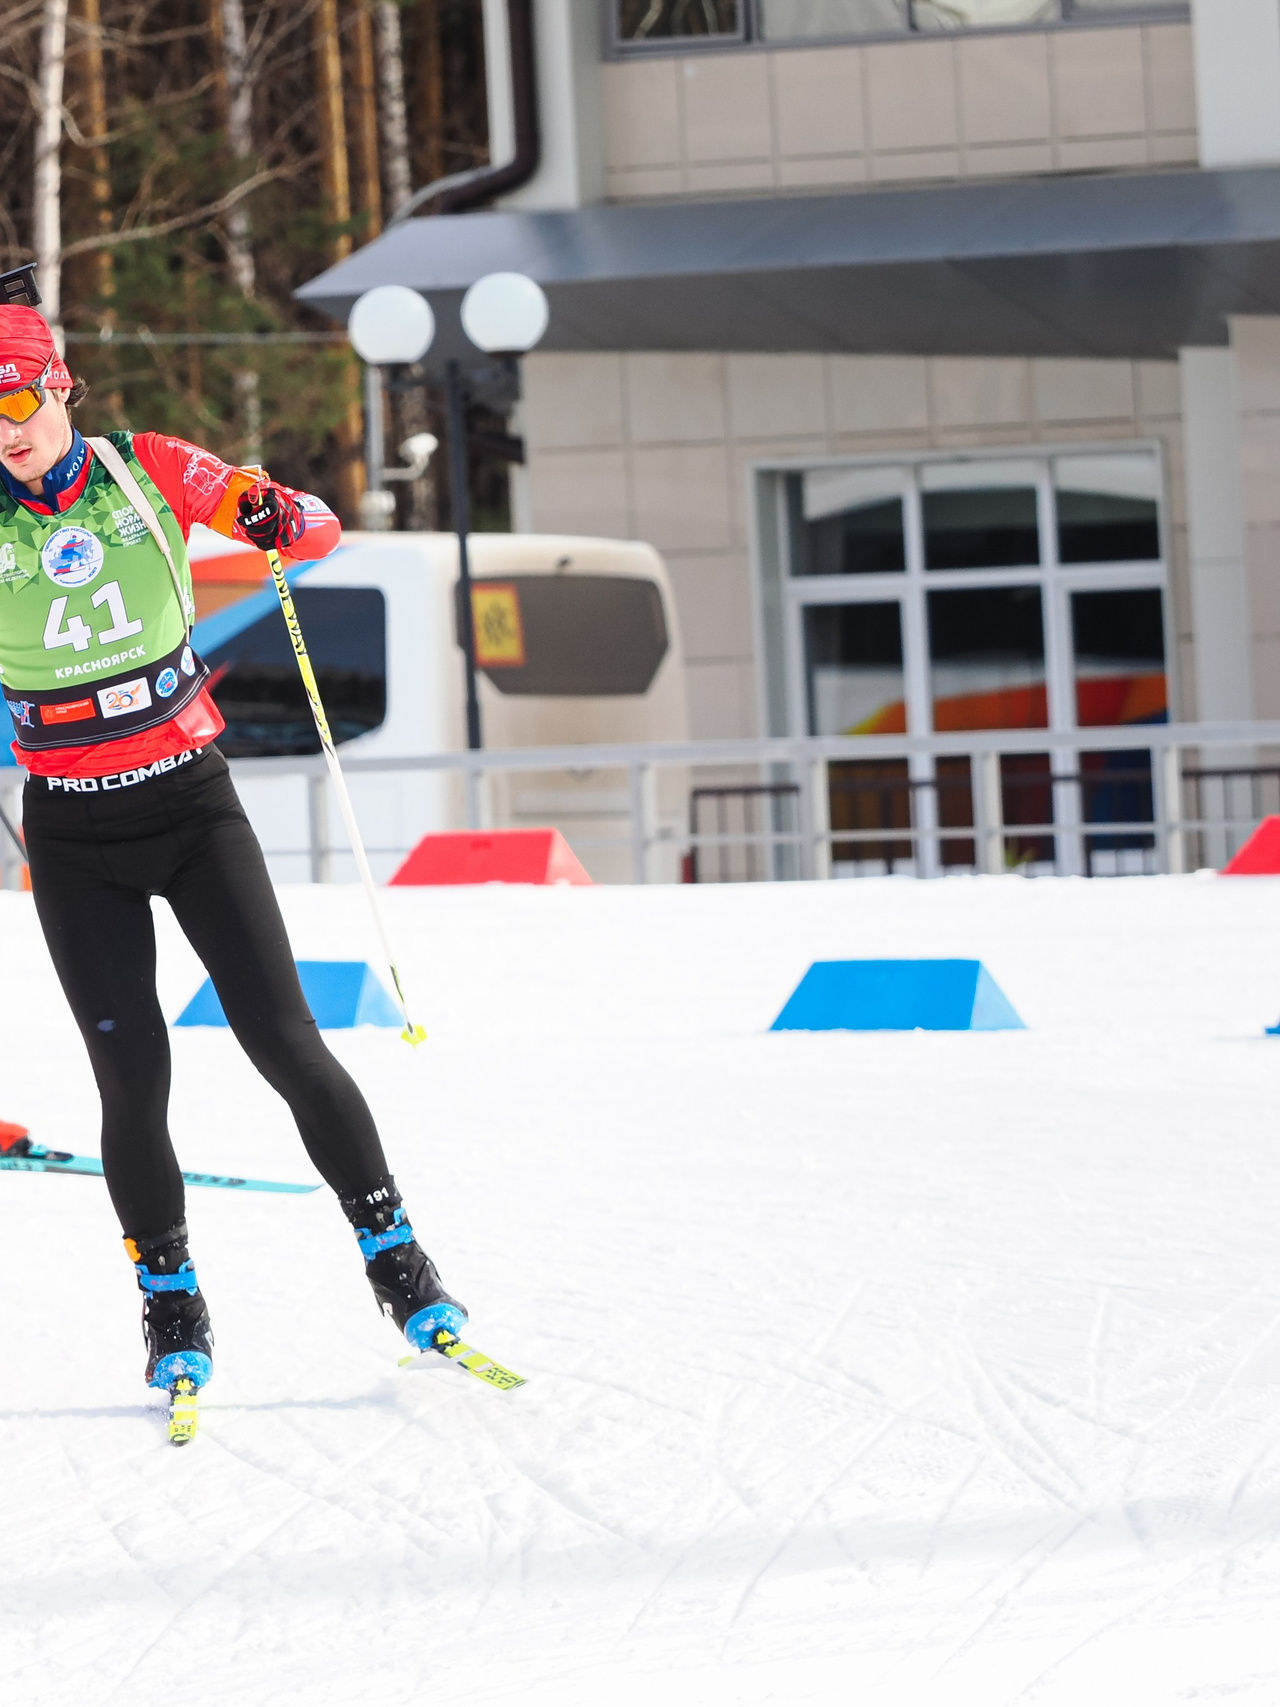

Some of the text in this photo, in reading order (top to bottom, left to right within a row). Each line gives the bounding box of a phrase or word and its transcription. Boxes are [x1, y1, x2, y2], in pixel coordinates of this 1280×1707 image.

[244, 506, 271, 526] LEKI
[43, 580, 144, 652] 41
[55, 644, 147, 680] КРАСНОЯРСК
[46, 776, 99, 792] PRO
[366, 1186, 390, 1205] 191
